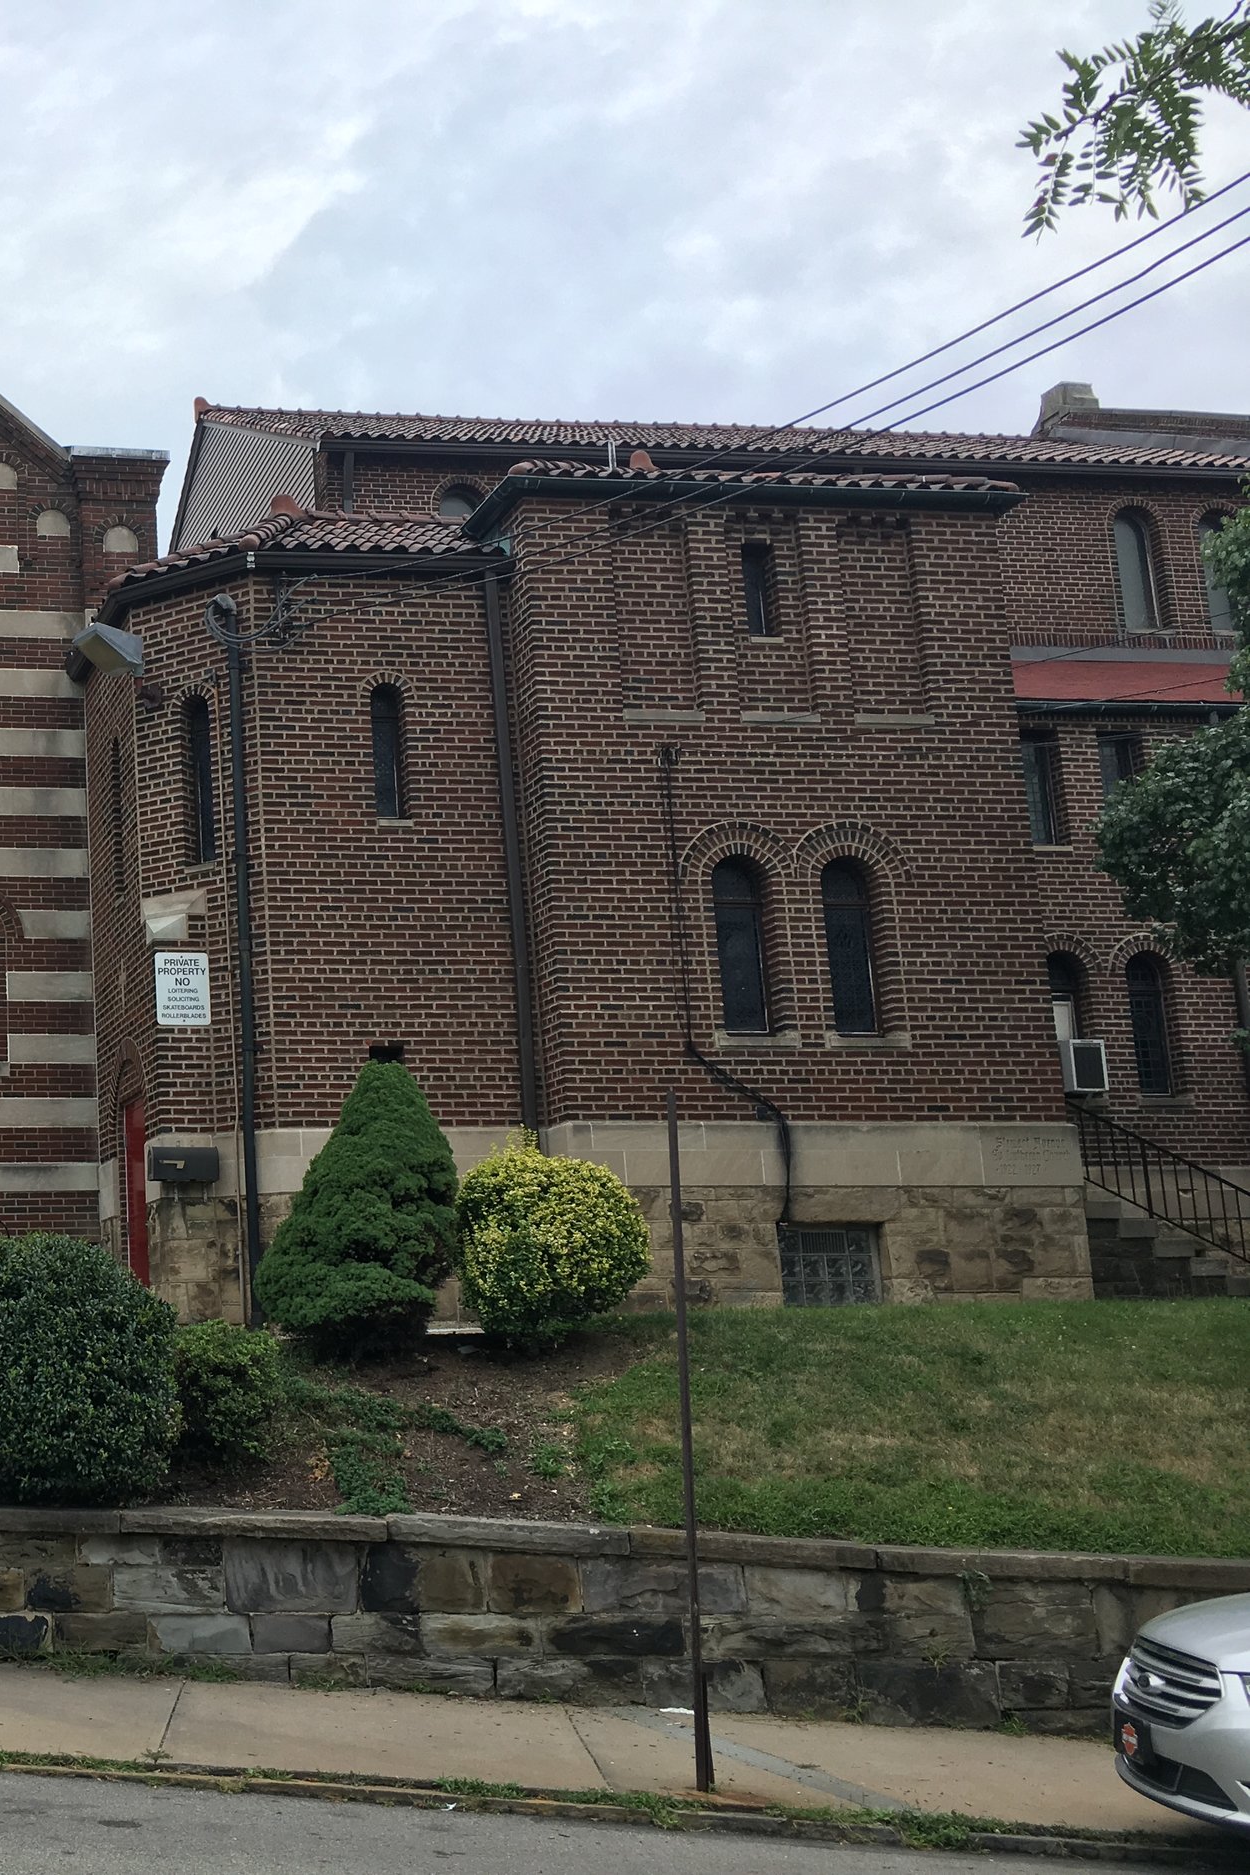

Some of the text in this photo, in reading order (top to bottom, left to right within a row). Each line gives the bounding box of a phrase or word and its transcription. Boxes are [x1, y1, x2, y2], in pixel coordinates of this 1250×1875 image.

[164, 958, 200, 967] PRIVATE
[157, 967, 206, 976] PROPERTY
[174, 977, 191, 986] NO
